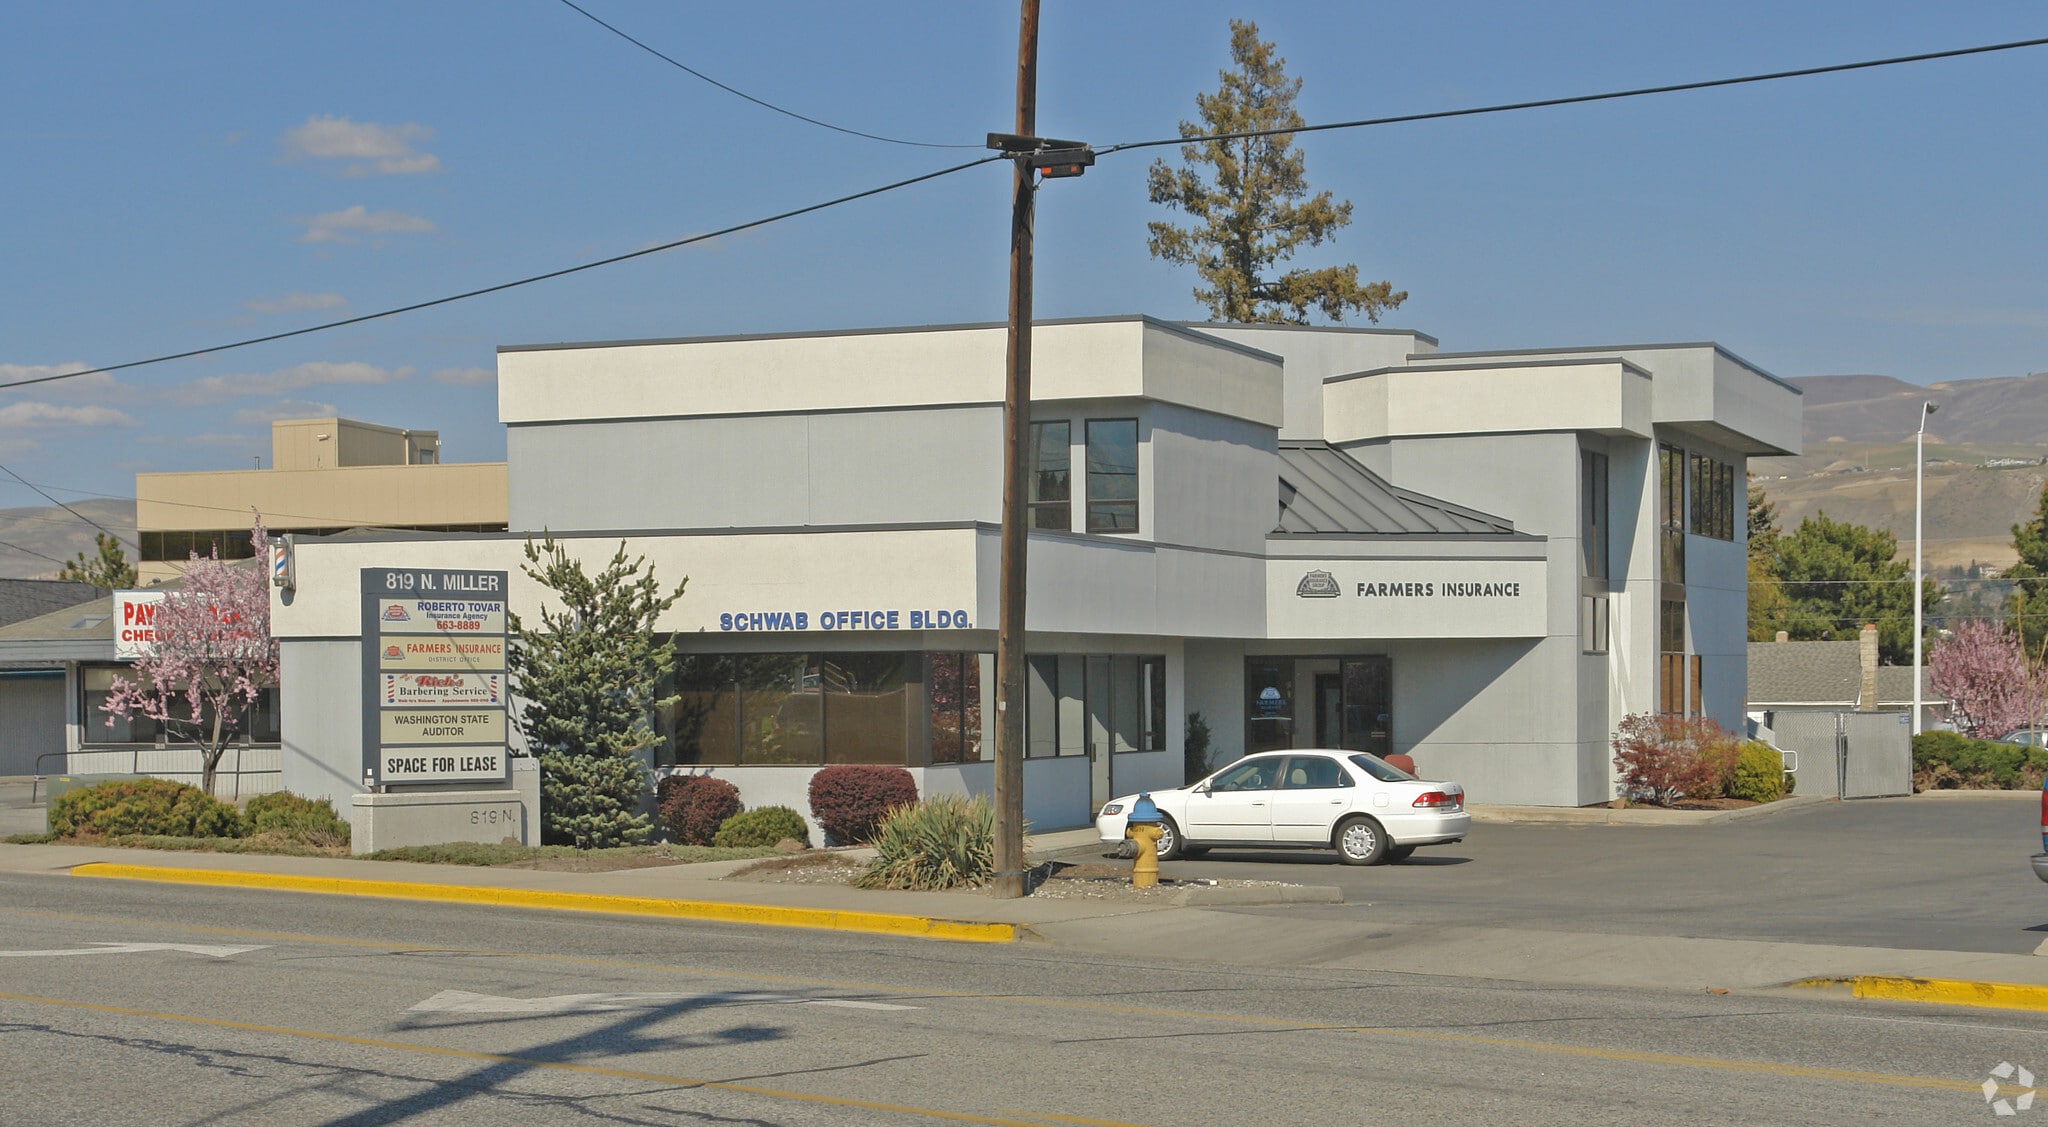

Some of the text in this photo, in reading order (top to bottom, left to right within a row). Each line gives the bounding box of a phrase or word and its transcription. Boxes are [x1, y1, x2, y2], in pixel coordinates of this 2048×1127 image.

[386, 572, 499, 591] 819 N. MILLER
[1357, 582, 1520, 597] FARMERS INSURANCE
[417, 602, 501, 612] ROBERTO TOVAR
[462, 613, 488, 621] Agency
[719, 610, 973, 631] SCHWAB OFFICE BLDG.
[436, 621, 481, 630] 663-8889
[407, 643, 452, 654] FARMERS
[456, 644, 501, 654] INSURANCE
[400, 686, 488, 697] Barbering Service
[394, 715, 489, 725] WASHINGTON STATE
[422, 727, 464, 736] AUDITOR
[387, 756, 497, 774] SPACE FOR LEASE
[470, 809, 516, 825] 819 N.
